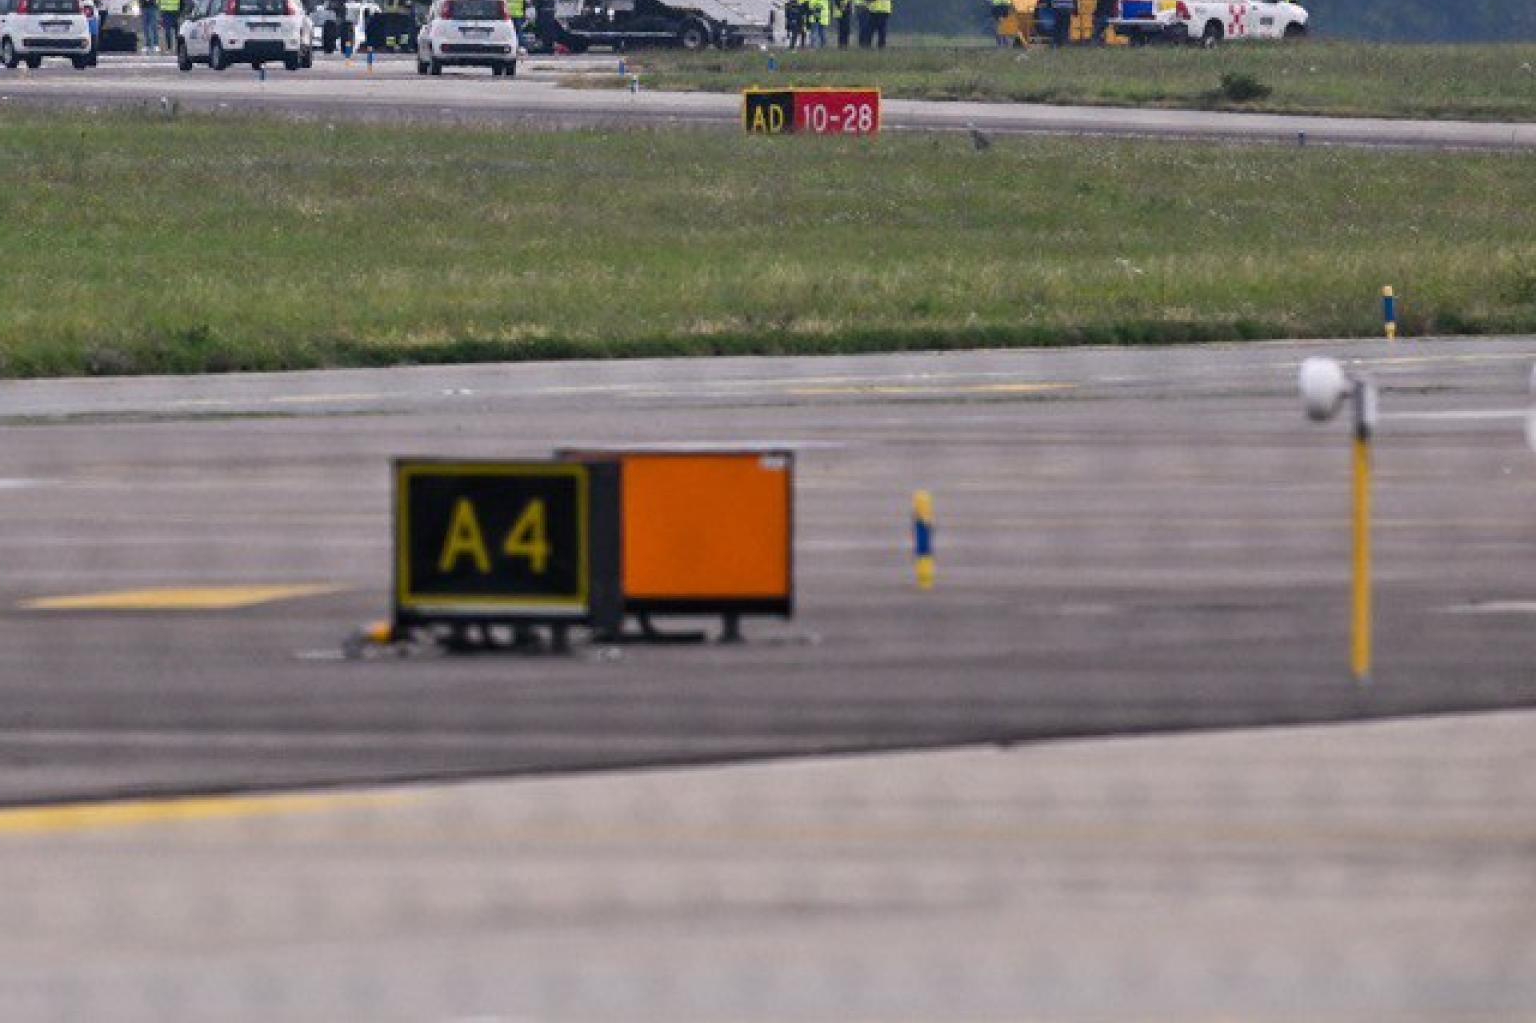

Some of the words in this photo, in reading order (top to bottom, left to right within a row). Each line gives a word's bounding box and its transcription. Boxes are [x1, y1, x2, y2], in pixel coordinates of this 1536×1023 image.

[752, 103, 783, 134] AD
[803, 103, 873, 133] 10-28
[437, 496, 553, 574] A4
